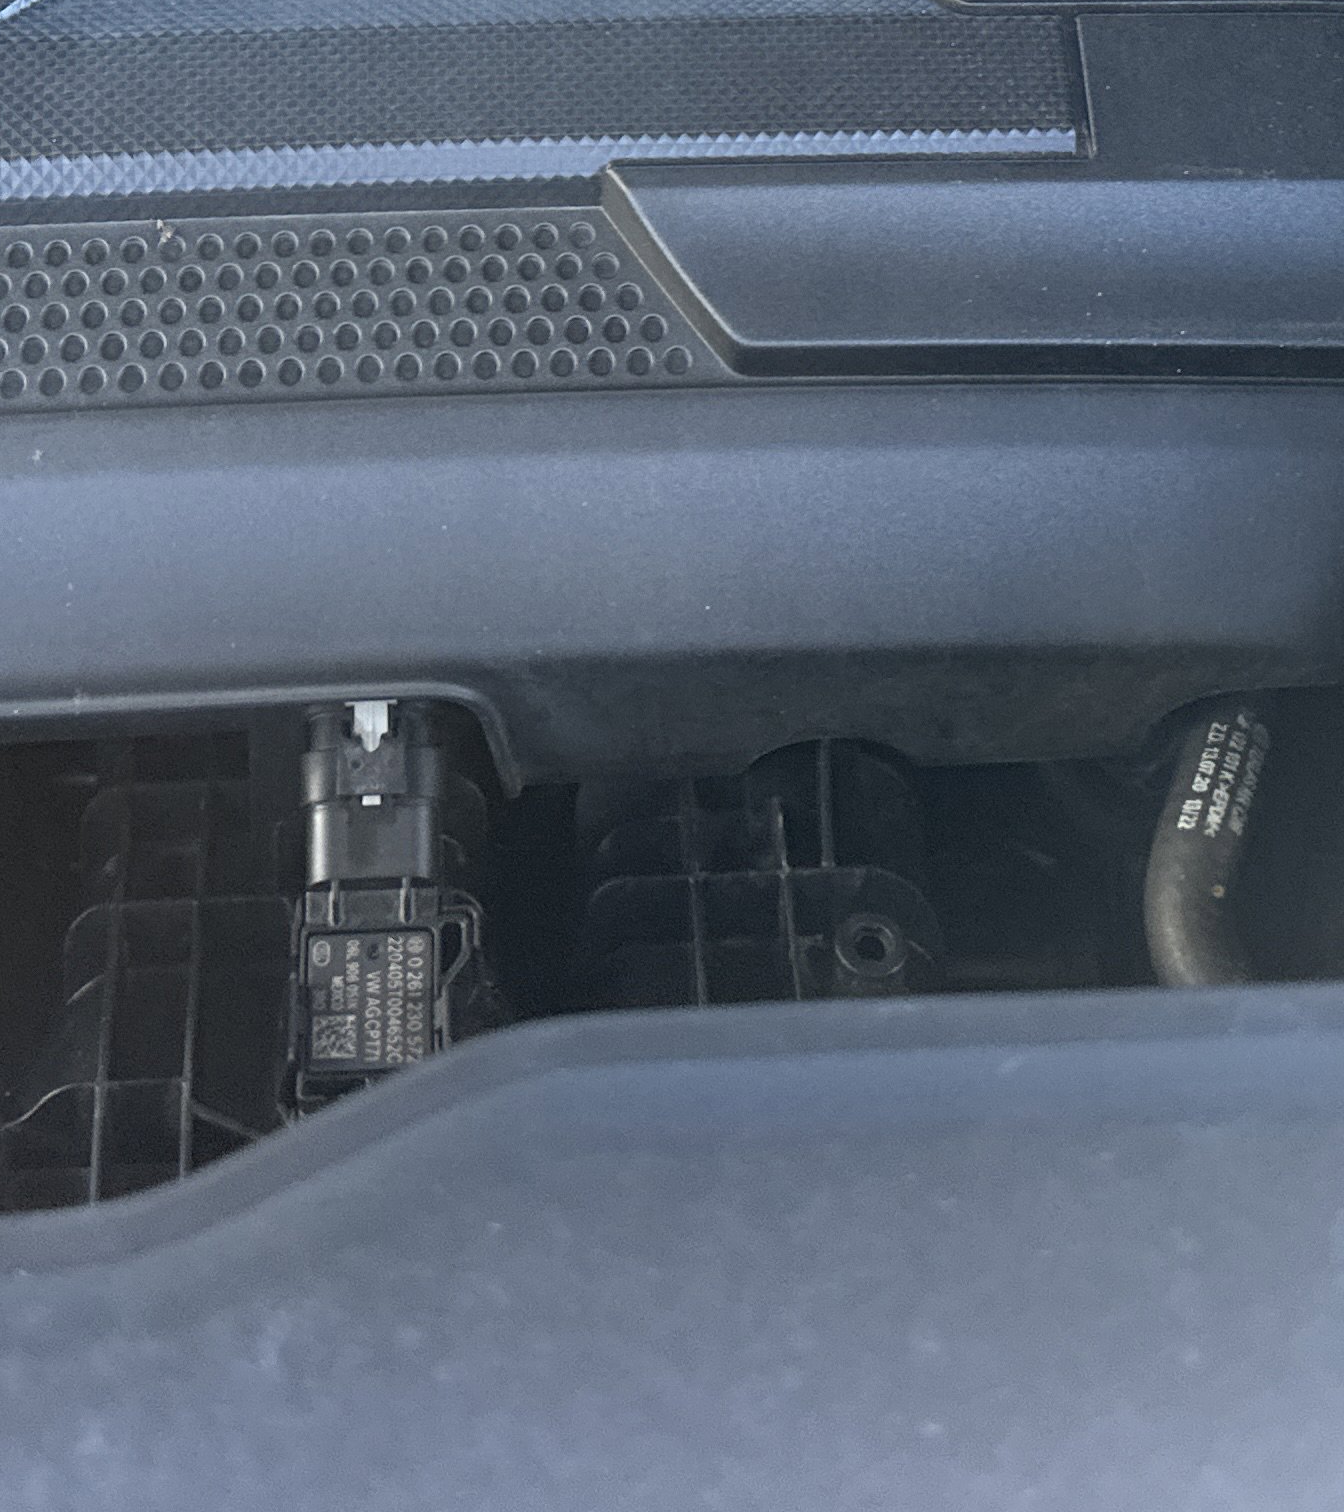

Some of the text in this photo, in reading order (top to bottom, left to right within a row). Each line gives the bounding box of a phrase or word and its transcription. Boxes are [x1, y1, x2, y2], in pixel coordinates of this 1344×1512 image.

[407, 956, 424, 968] 0
[365, 970, 382, 994] VW
[407, 971, 424, 997] 261
[365, 998, 382, 1019] AG
[406, 1002, 424, 1032] 230
